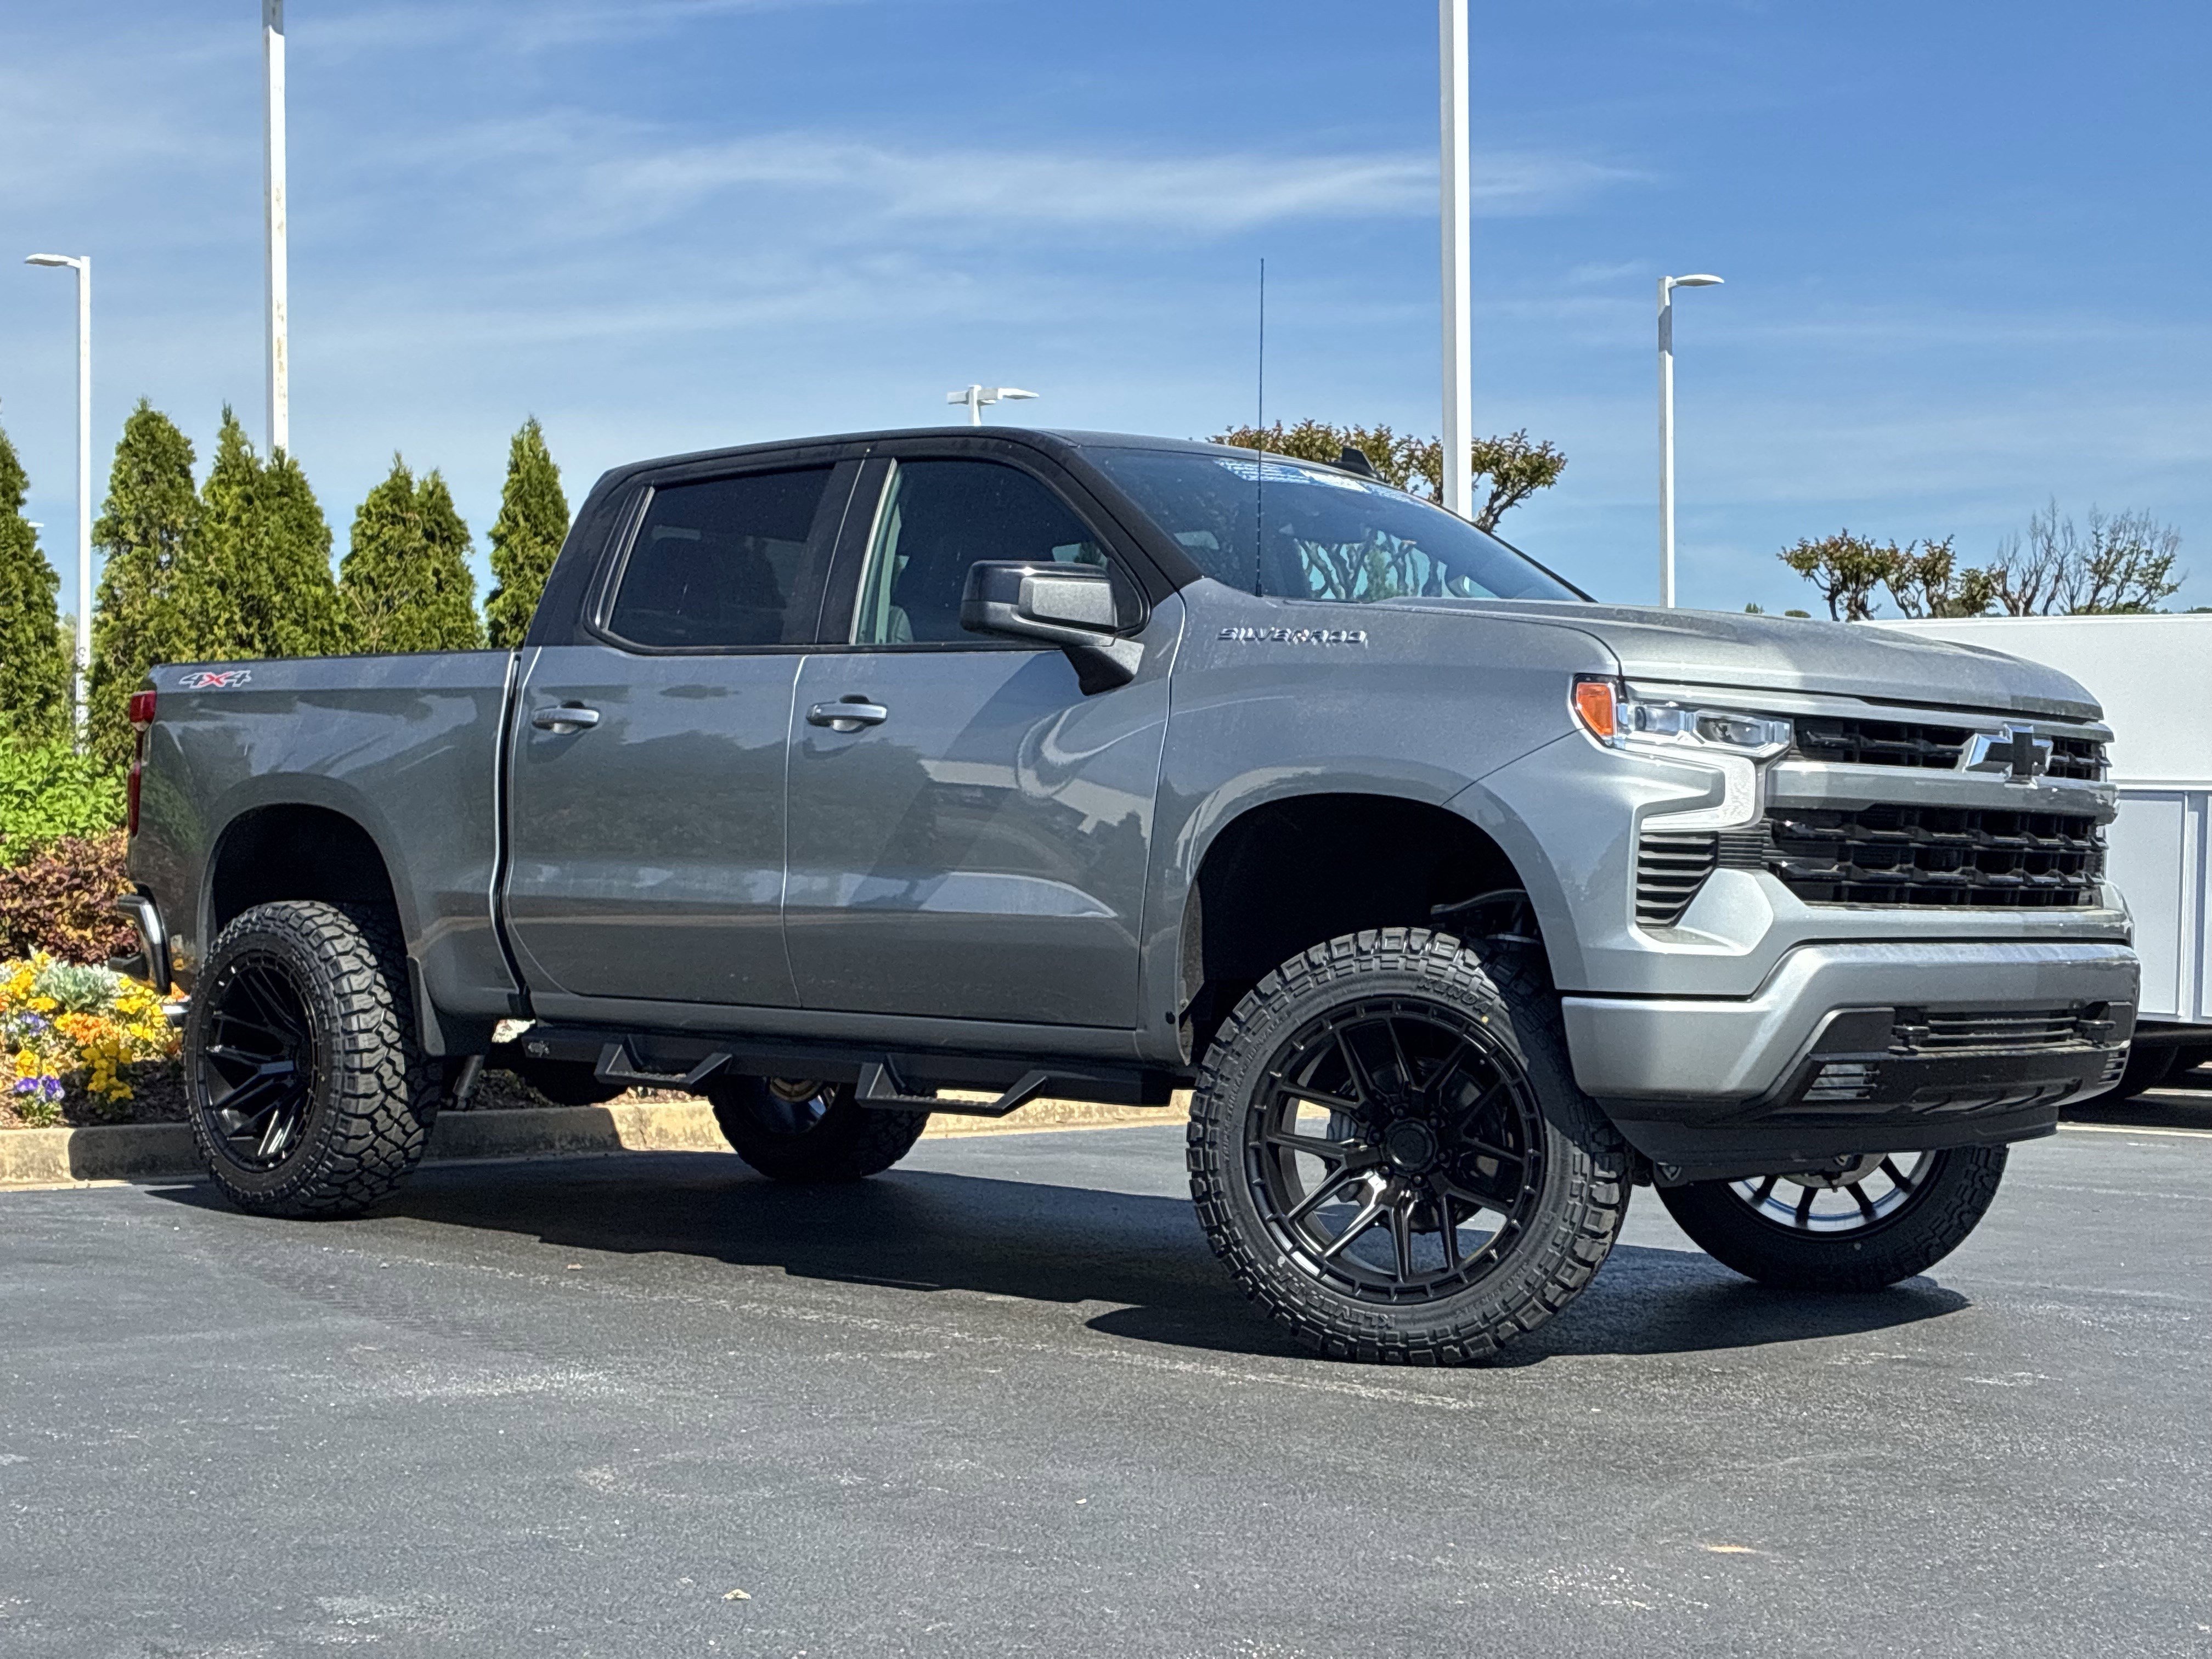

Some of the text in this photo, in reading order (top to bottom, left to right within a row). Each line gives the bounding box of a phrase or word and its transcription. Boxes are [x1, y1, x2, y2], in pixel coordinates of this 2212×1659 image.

[1217, 627, 1367, 644] SILVERADO
[1417, 974, 1492, 1013] KENDA
[1307, 1290, 1396, 1328] KLEVER
